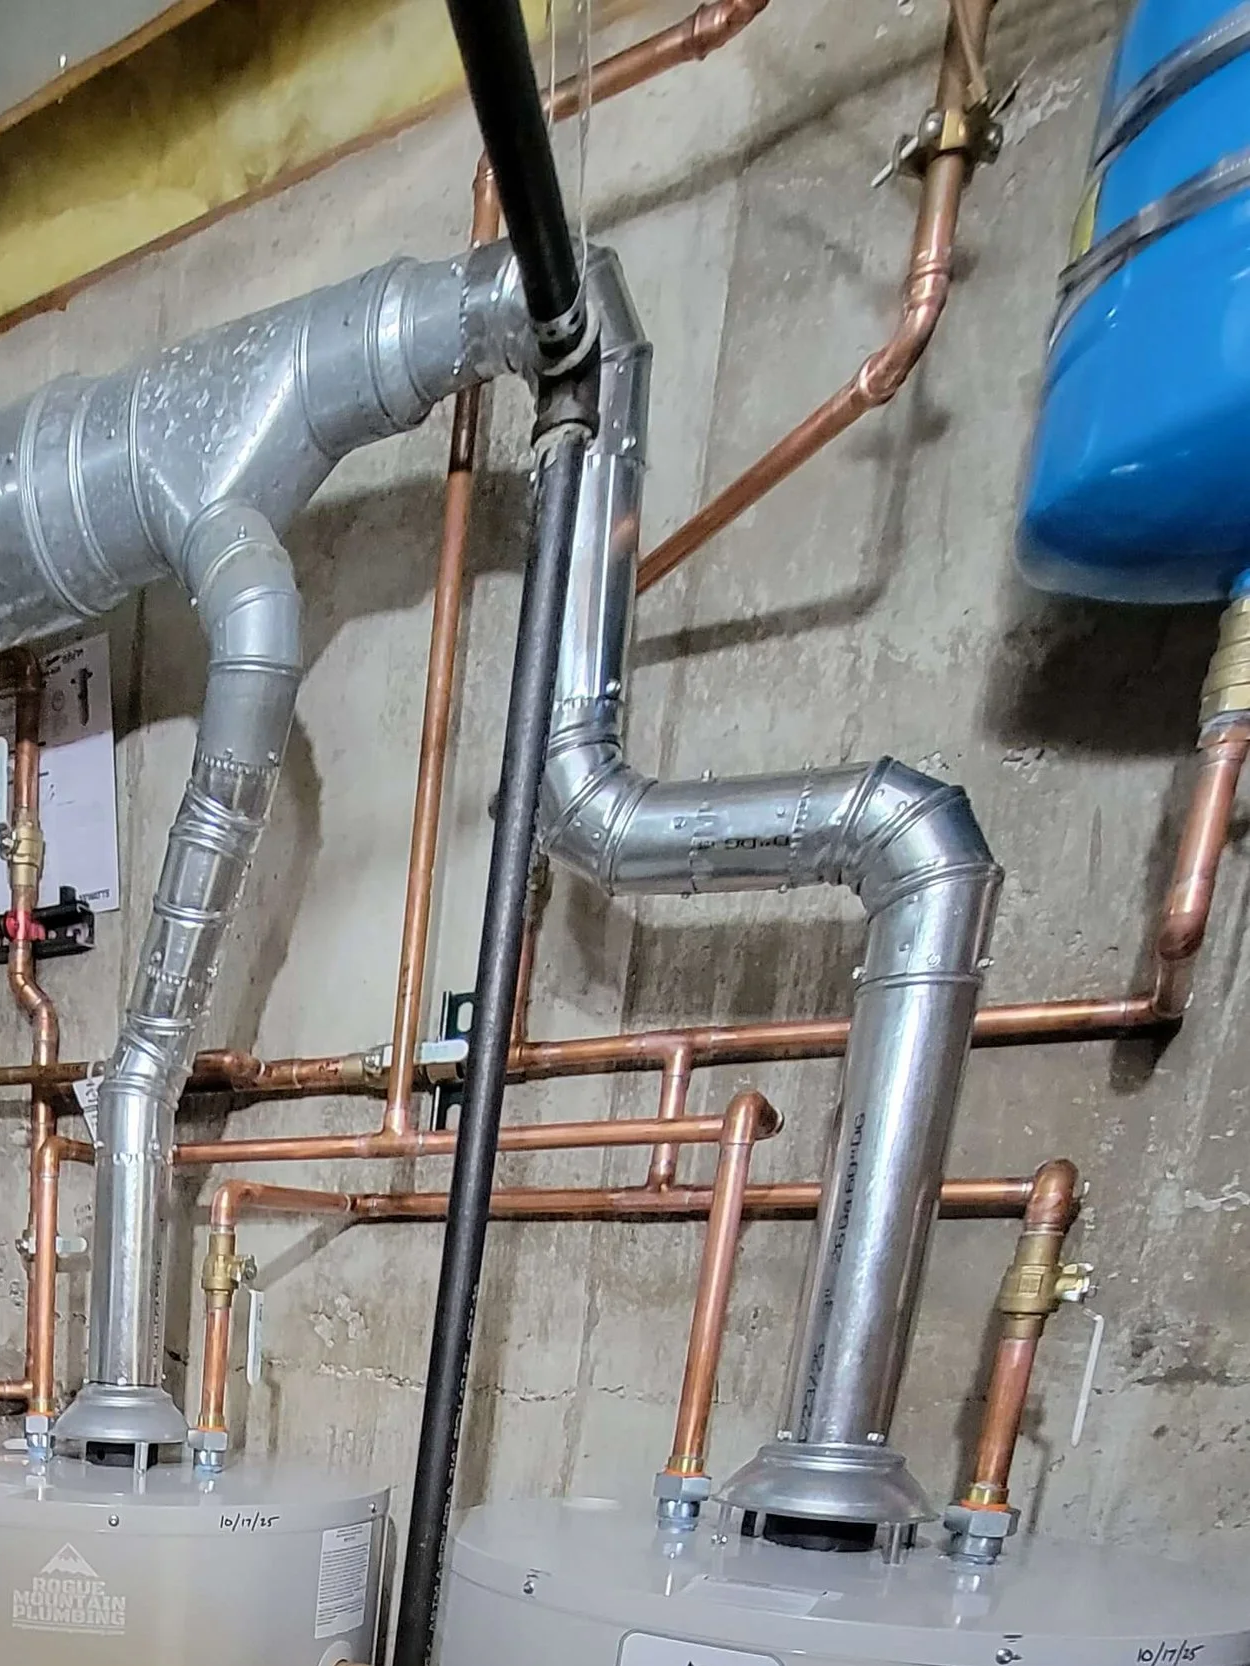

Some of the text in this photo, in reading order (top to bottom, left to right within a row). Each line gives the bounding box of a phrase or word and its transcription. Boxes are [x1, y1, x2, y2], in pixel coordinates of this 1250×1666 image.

[220, 1511, 280, 1532] 10/17/25
[32, 1577, 106, 1596] ROGUE
[13, 1589, 126, 1612] MOUNTAIN
[12, 1604, 126, 1626] PLUMBING
